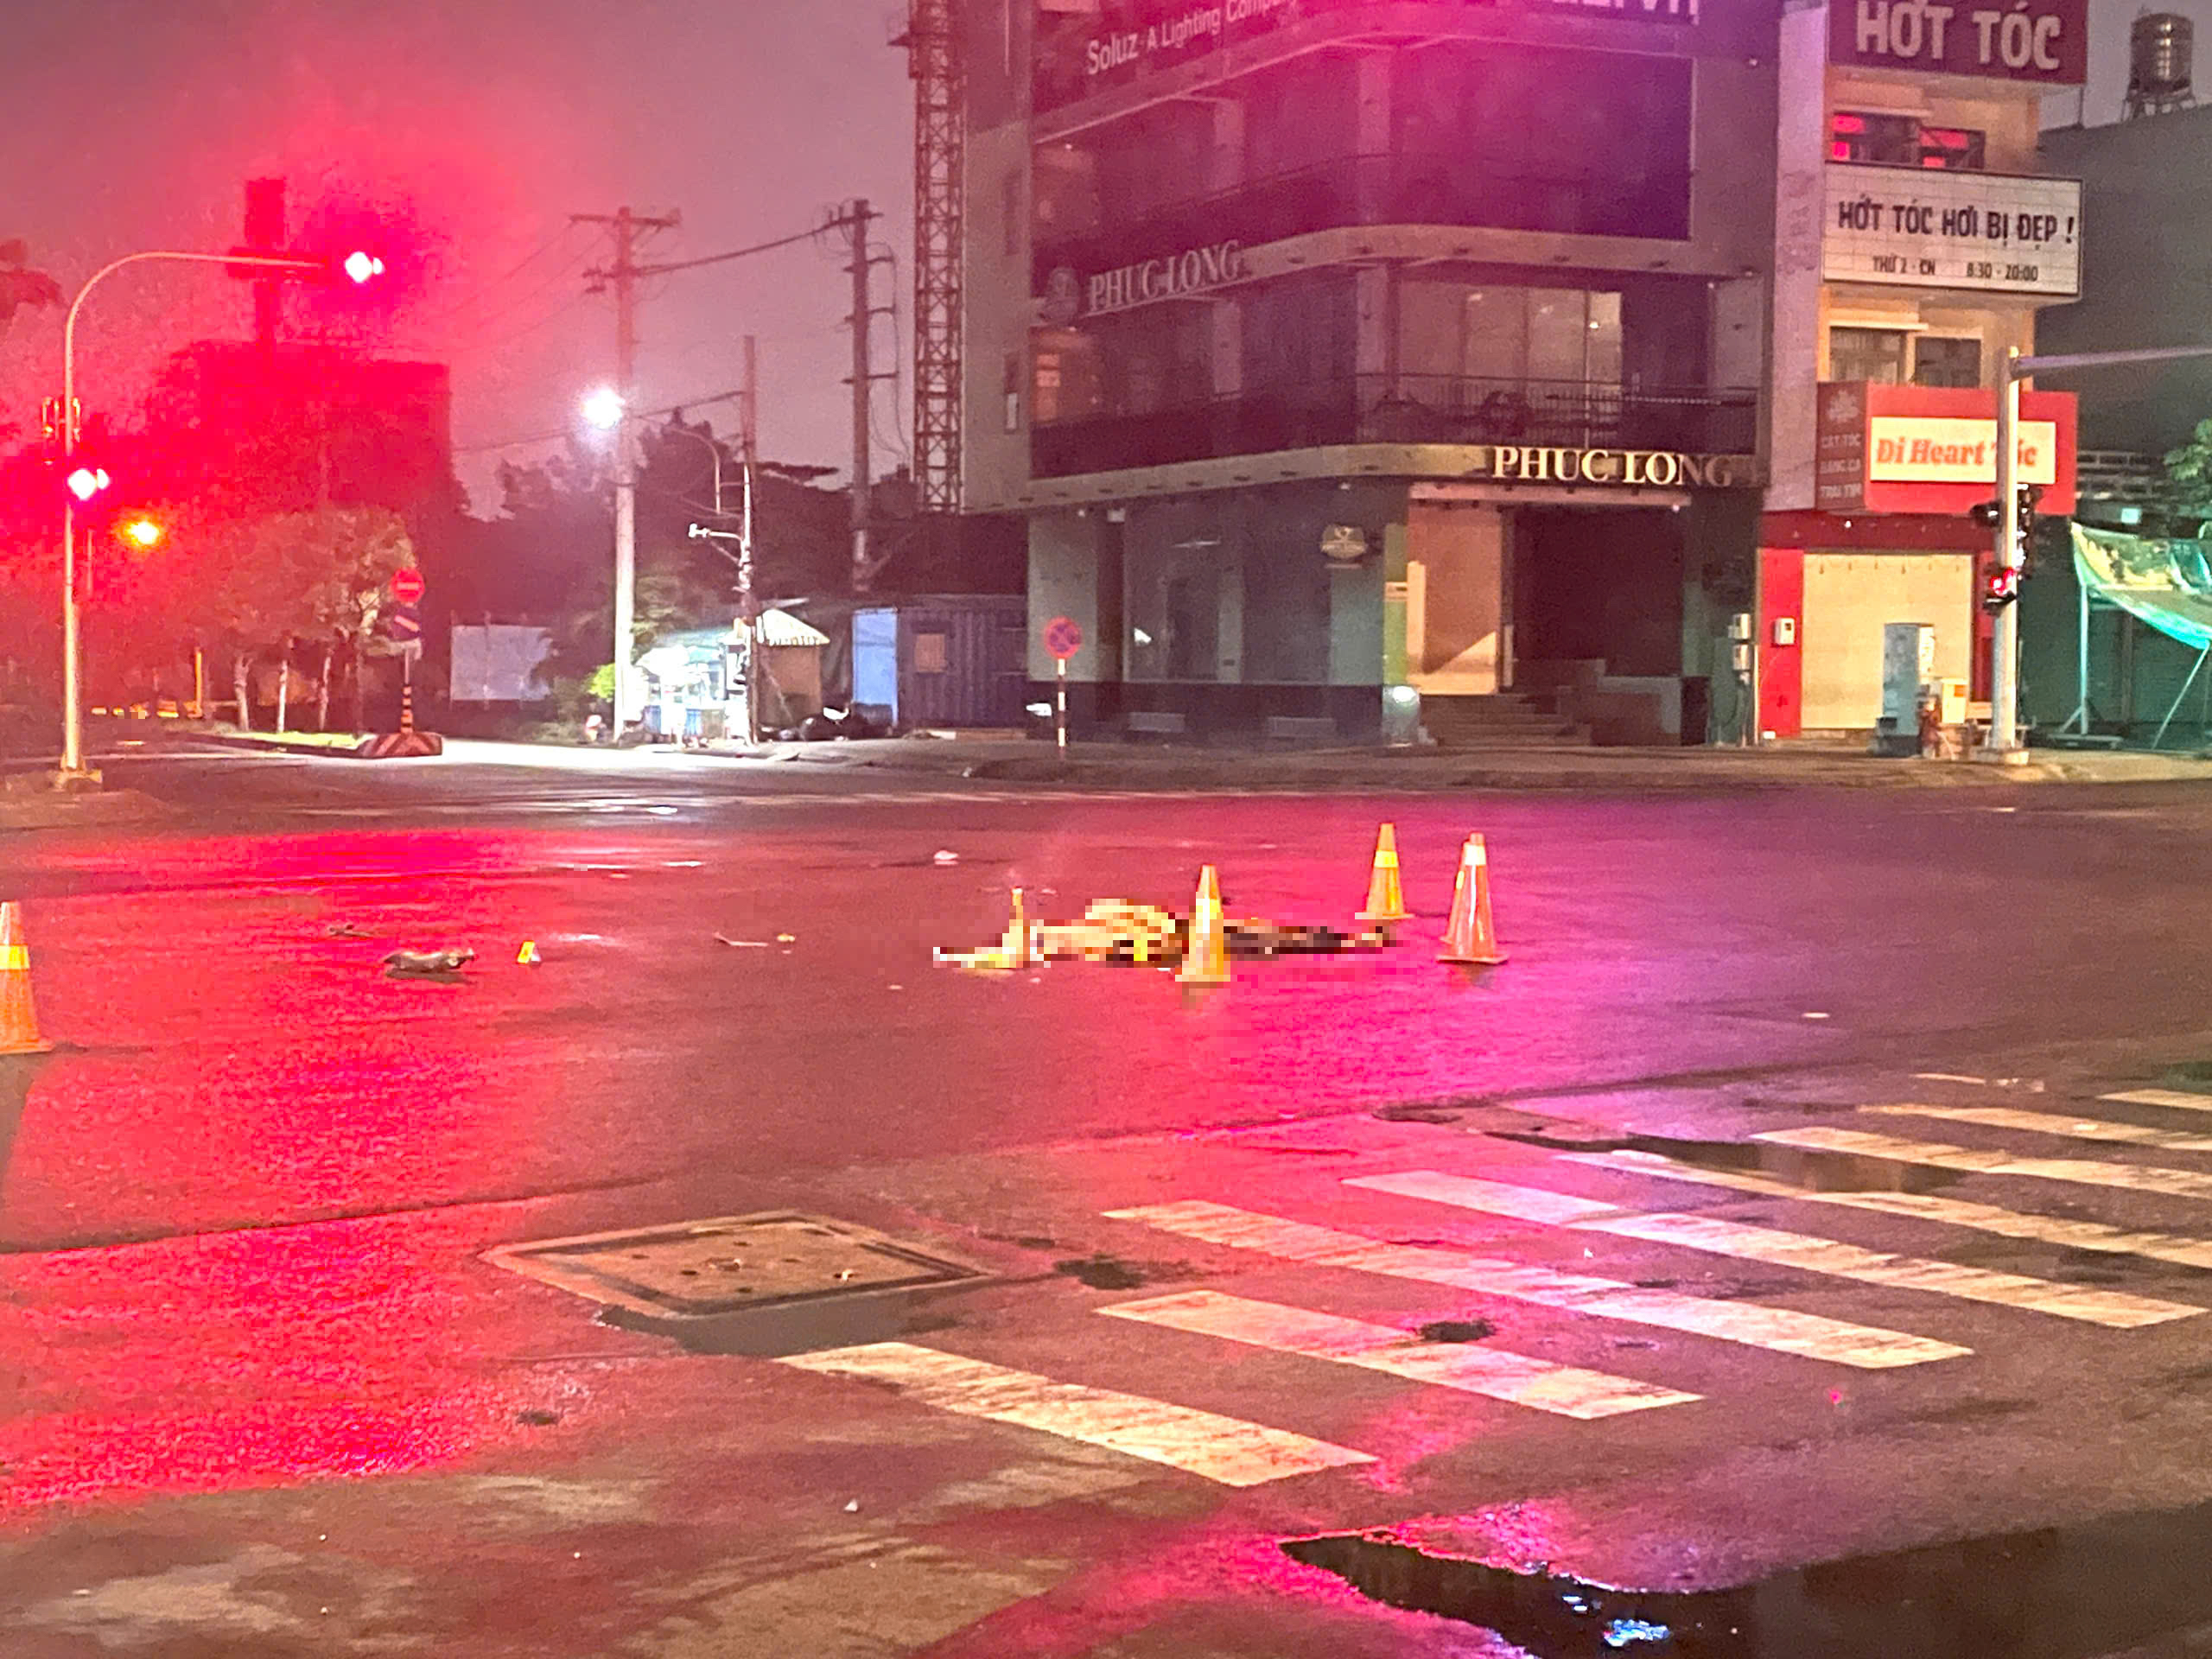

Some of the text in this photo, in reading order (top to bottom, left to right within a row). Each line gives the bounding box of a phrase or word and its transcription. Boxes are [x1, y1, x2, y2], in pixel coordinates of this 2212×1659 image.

[1087, 33, 1138, 75] Soluz
[1147, 26, 1158, 50] A
[1161, 8, 1221, 48] Lighting
[1972, 1, 2062, 69] TÓC
[1892, 199, 1933, 234] TÓC
[2017, 213, 2057, 251] ĐẸP
[2066, 217, 2074, 244] !
[1492, 445, 1732, 488] PHUC LONG
[1908, 438, 1986, 467] Heart
